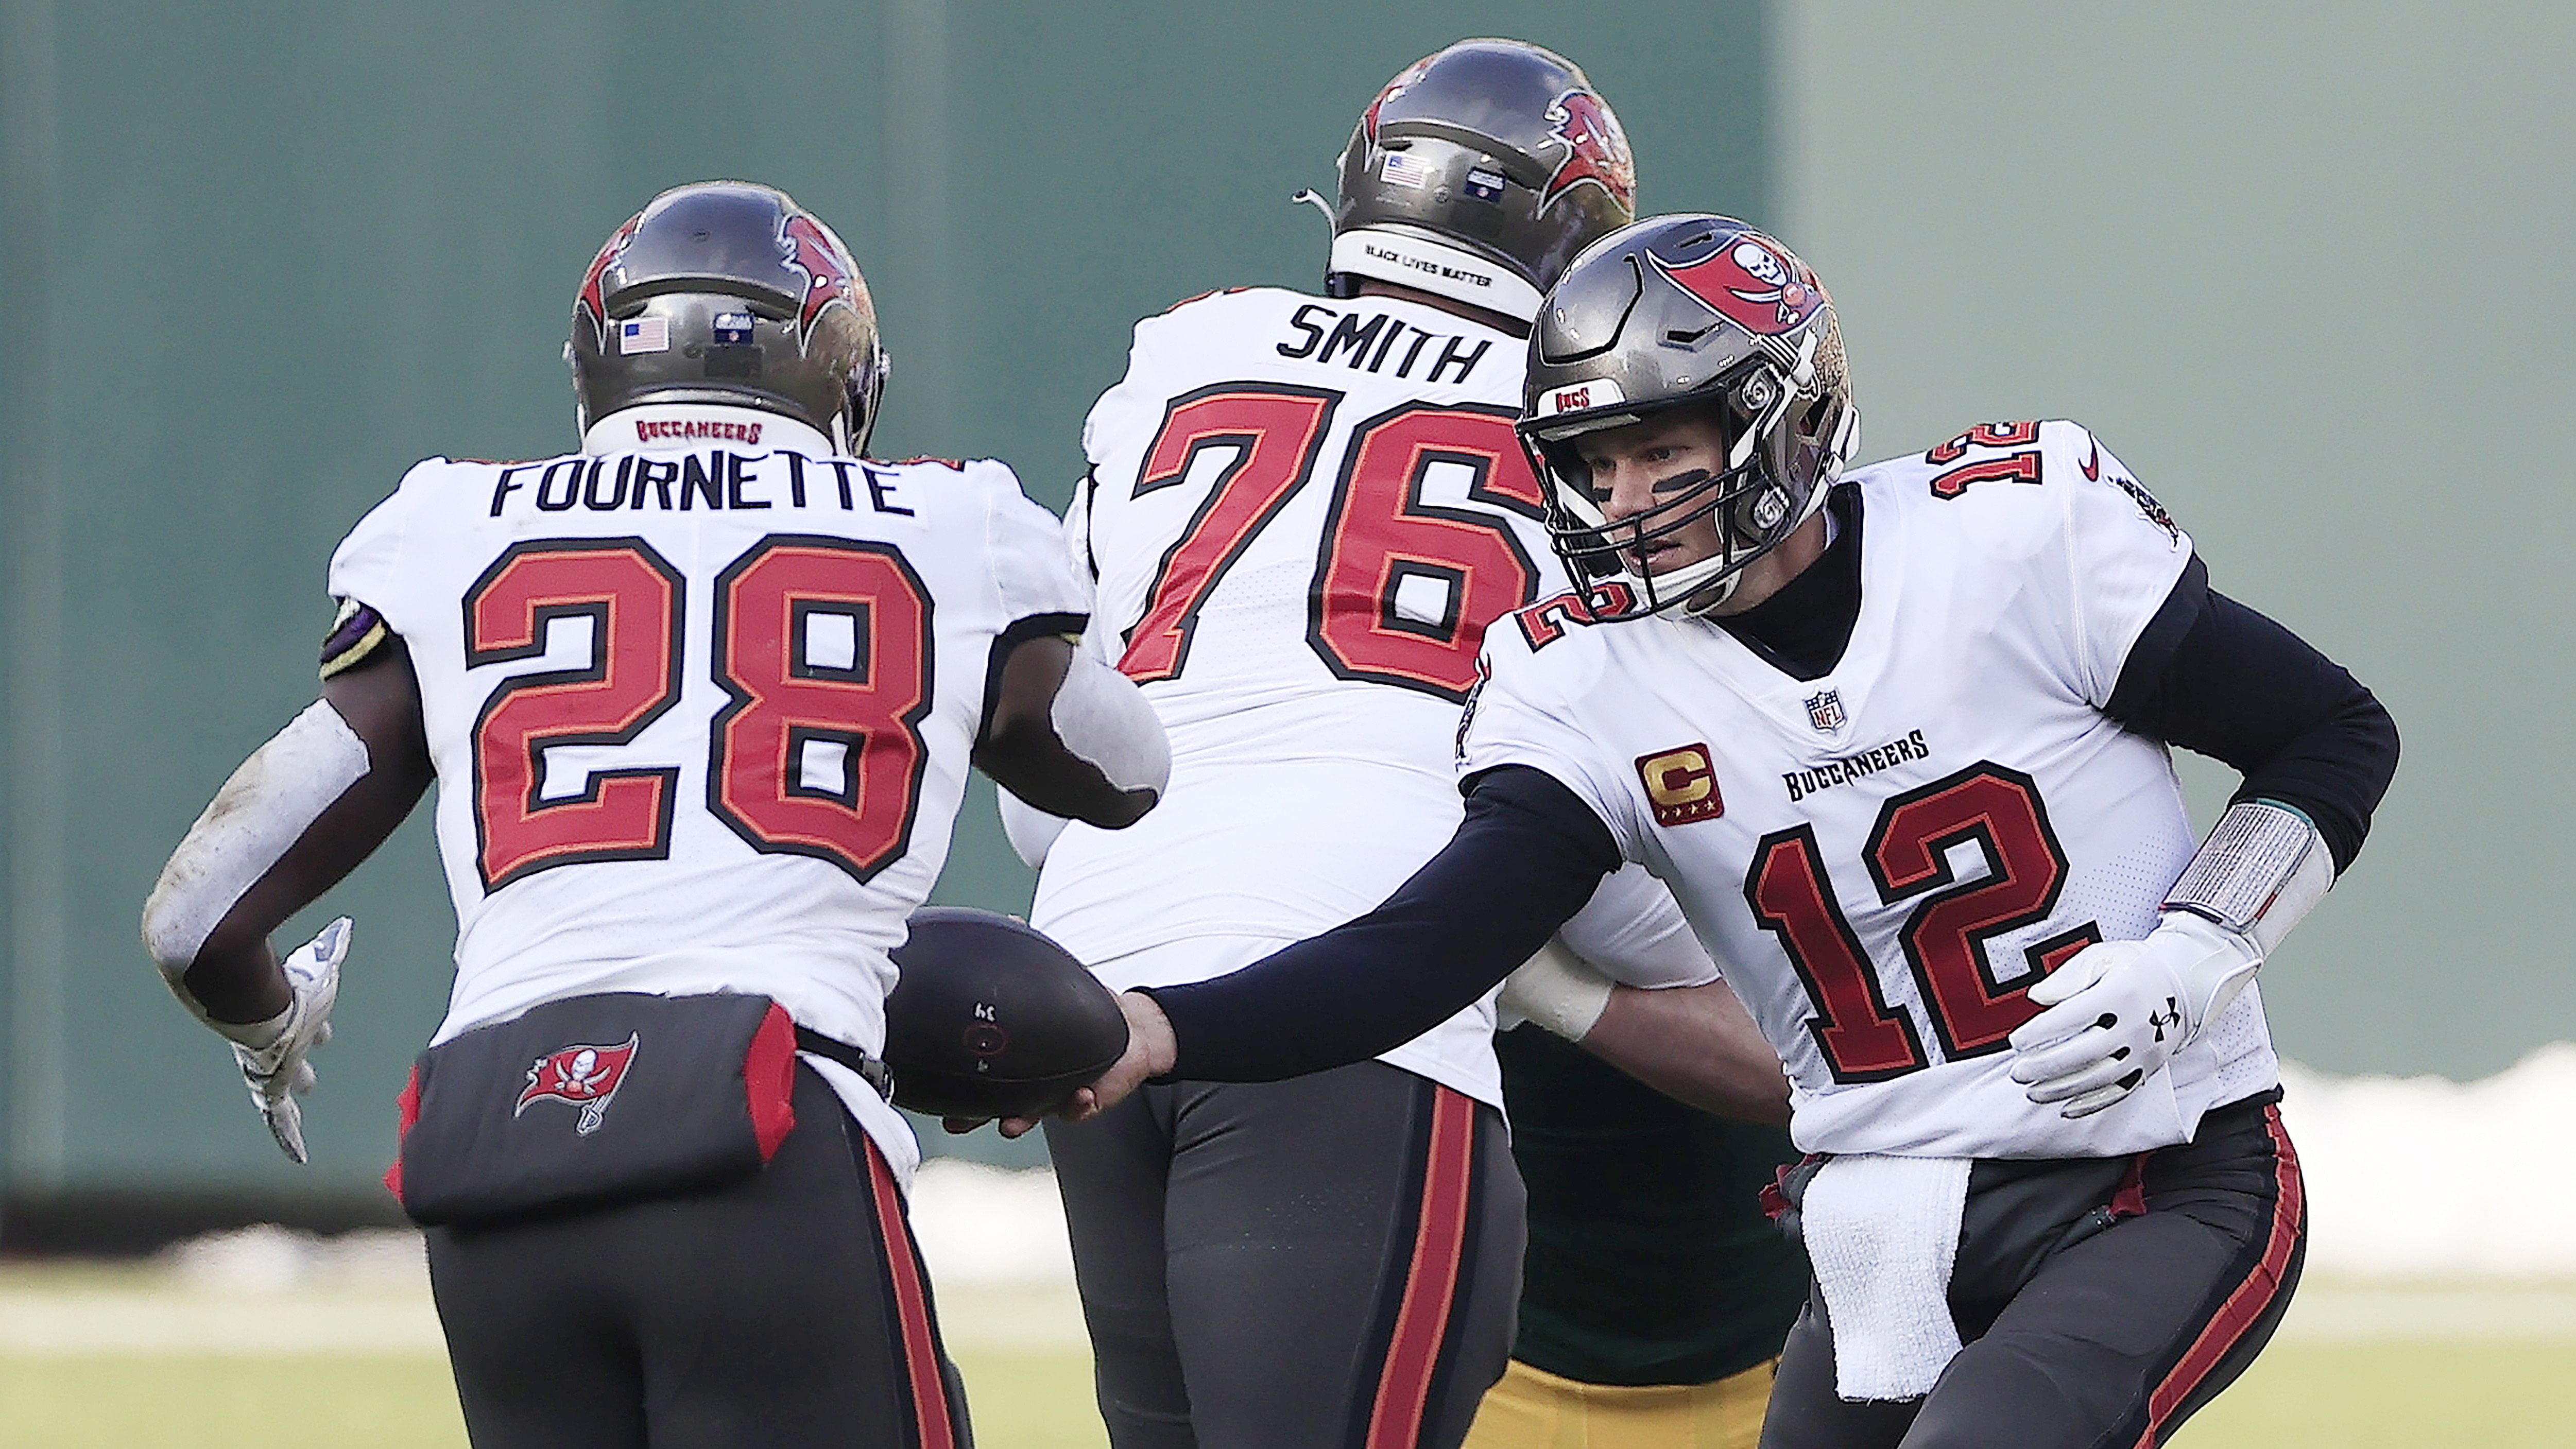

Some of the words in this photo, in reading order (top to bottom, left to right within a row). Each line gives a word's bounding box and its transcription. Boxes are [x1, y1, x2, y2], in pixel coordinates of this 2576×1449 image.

[1276, 304, 1492, 384] SMITH
[636, 420, 762, 445] BUCCANEERS
[490, 450, 915, 517] FOURNETTE
[1115, 380, 1546, 705] 76
[461, 532, 935, 898] 28
[1814, 705, 1841, 726] NFL
[1643, 751, 1711, 805] C
[1782, 729, 1929, 802] BUCCANEERS
[1743, 760, 2103, 1084] 12
